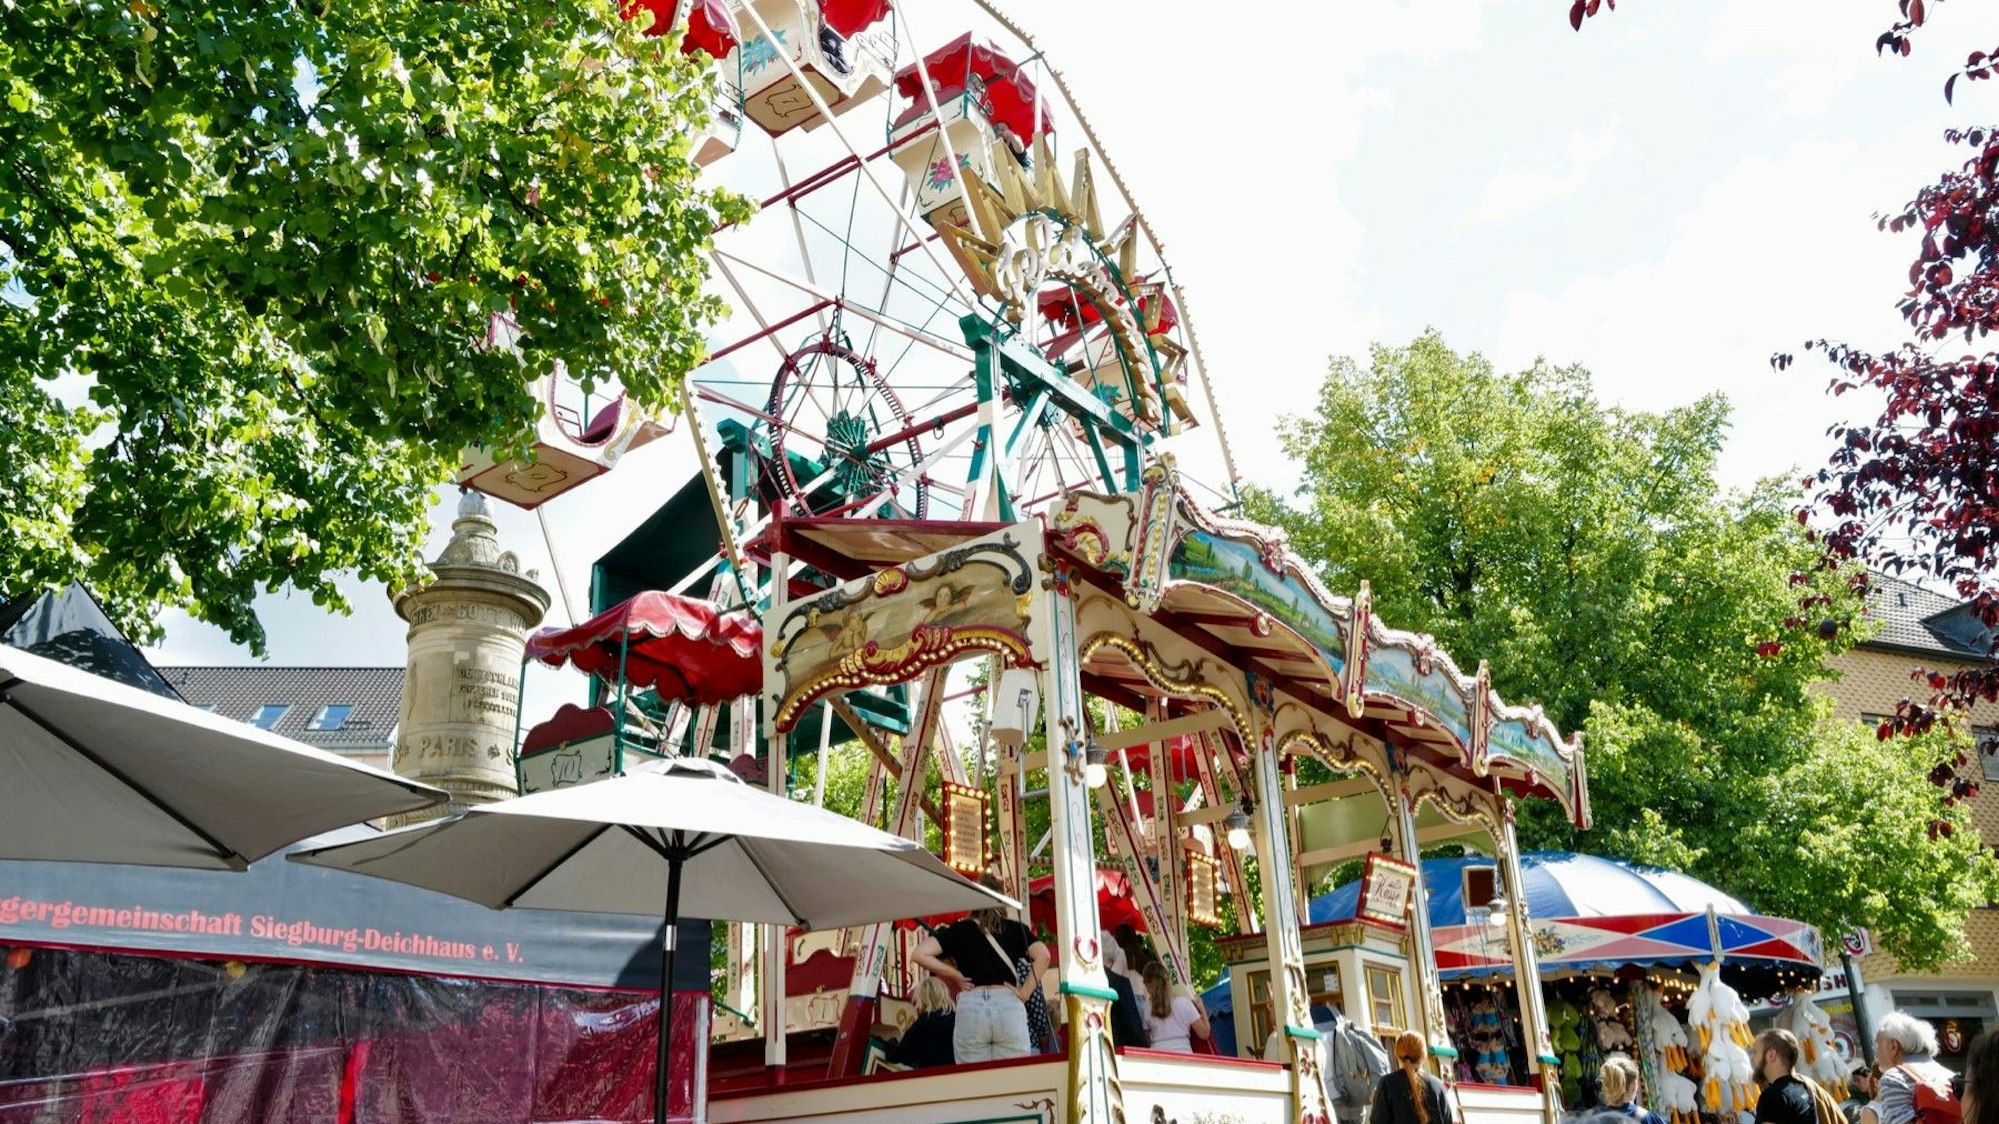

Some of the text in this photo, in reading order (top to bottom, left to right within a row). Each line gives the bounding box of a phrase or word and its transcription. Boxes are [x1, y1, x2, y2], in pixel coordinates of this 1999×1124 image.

[457, 603, 503, 623] GOTT
[419, 735, 478, 758] PARIS
[0, 896, 525, 964] gergemeinschaft Siegburg-Deichhaus e. V.
